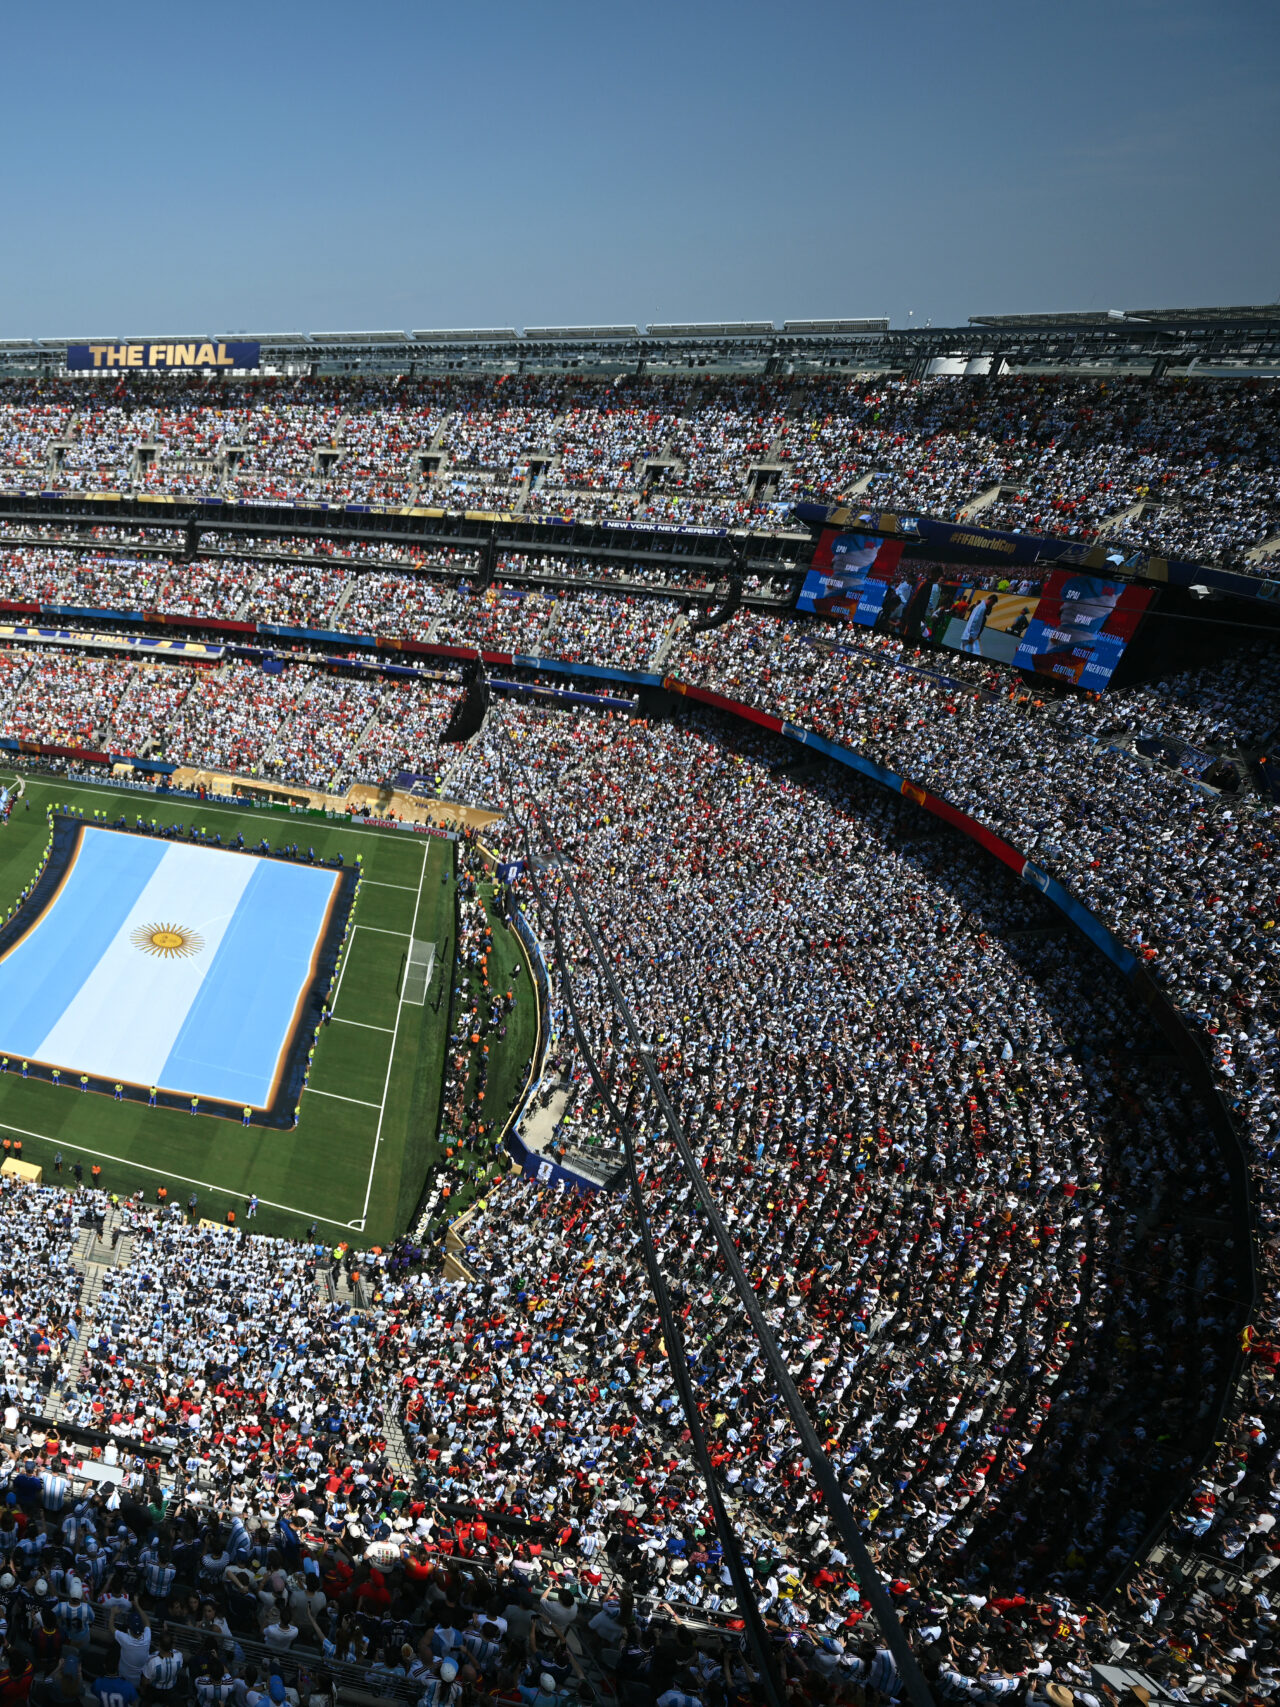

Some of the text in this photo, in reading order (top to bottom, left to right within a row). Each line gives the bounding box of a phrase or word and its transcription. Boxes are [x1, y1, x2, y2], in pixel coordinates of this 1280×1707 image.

[88, 343, 234, 366] THE FINAL
[681, 526, 720, 535] JERSEY
[949, 532, 1016, 554] #FIFAWorldCup
[93, 634, 131, 644] FINAL
[1041, 628, 1072, 643] ARGENTINA
[106, 780, 144, 790] AMERICA
[207, 794, 239, 805] ULTRA
[363, 818, 447, 838] verizon verizon
